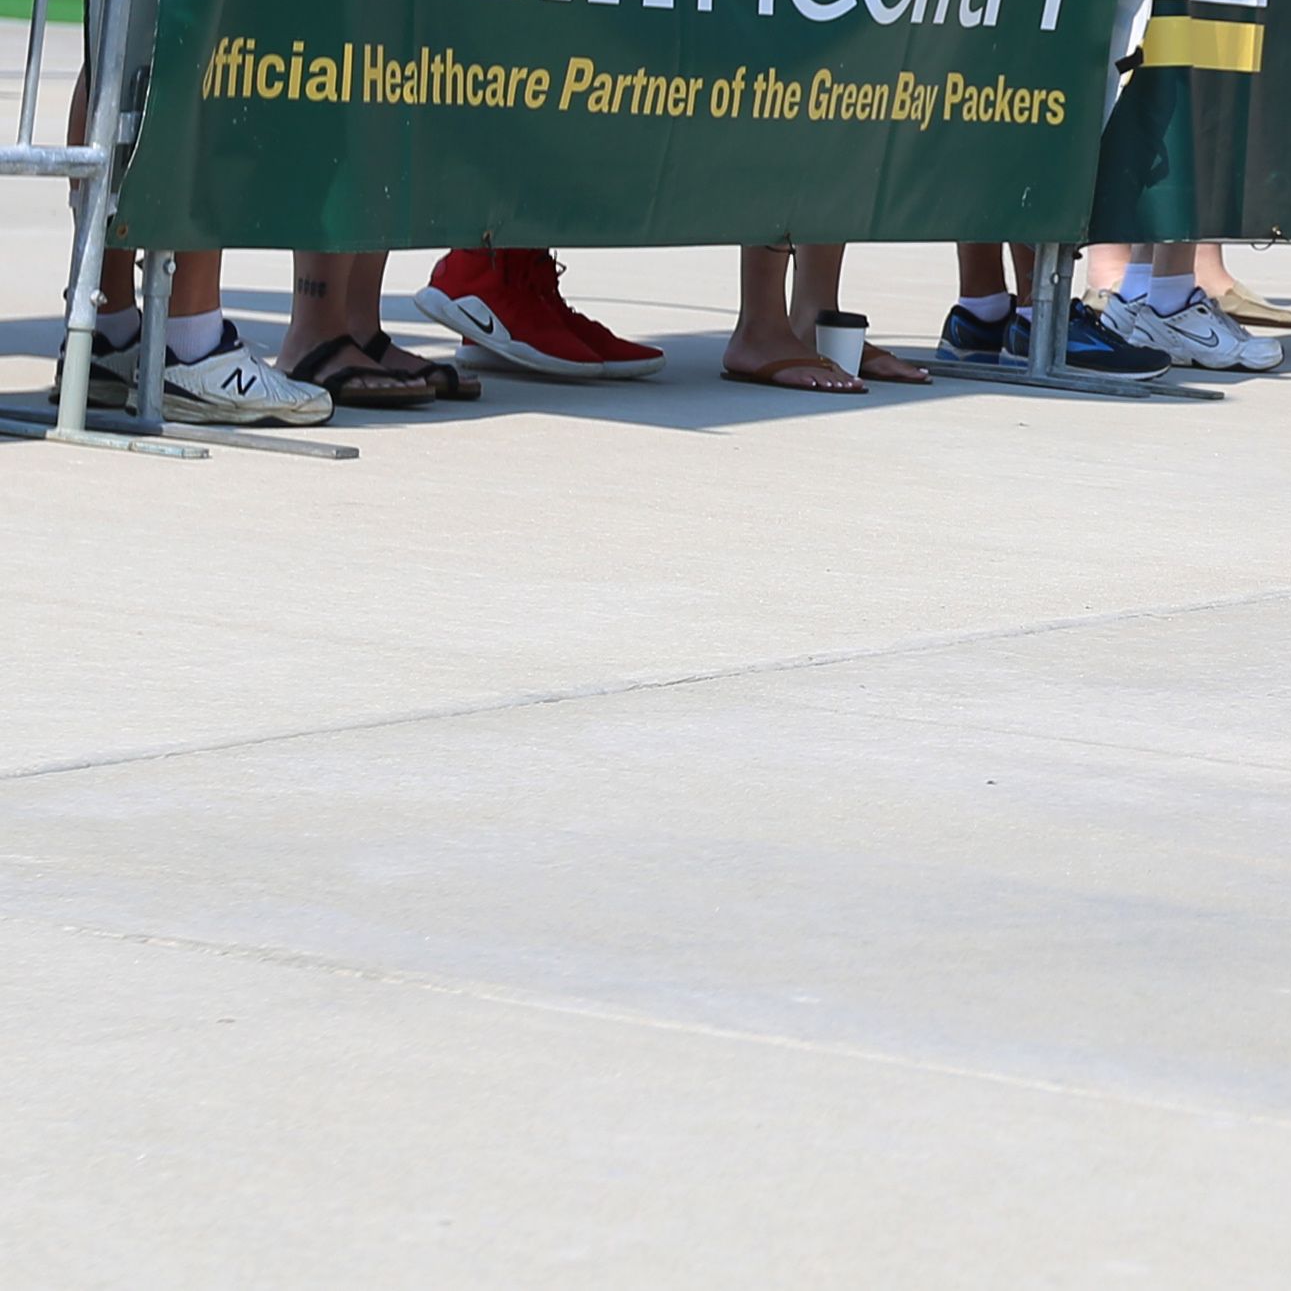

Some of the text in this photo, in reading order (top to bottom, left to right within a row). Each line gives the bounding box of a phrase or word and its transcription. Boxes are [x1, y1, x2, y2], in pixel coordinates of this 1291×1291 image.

[363, 43, 551, 108] Healthcare
[558, 55, 704, 116] Partner
[710, 65, 746, 118] of
[753, 67, 802, 120] the
[808, 67, 890, 121] Green
[891, 70, 939, 131] Bay
[943, 71, 1067, 126] Packers
